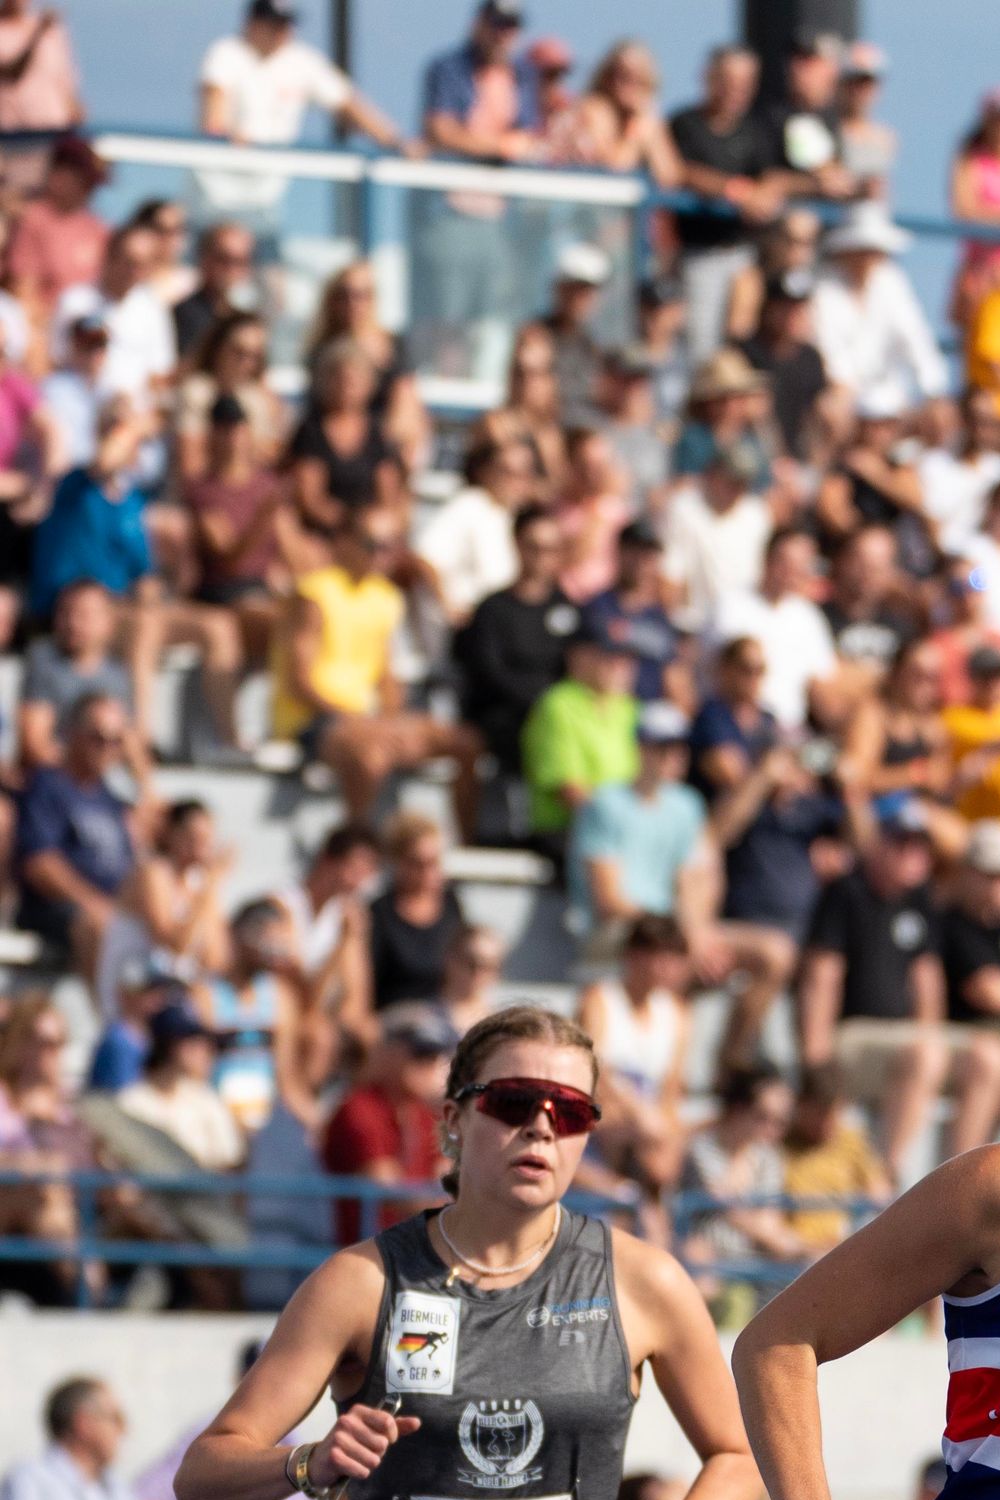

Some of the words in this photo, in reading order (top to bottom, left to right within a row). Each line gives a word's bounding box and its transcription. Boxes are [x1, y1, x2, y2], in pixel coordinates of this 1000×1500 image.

[401, 1308, 449, 1326] BIERMEILE
[552, 1308, 609, 1327] EXPERTS
[409, 1366, 428, 1381] GER
